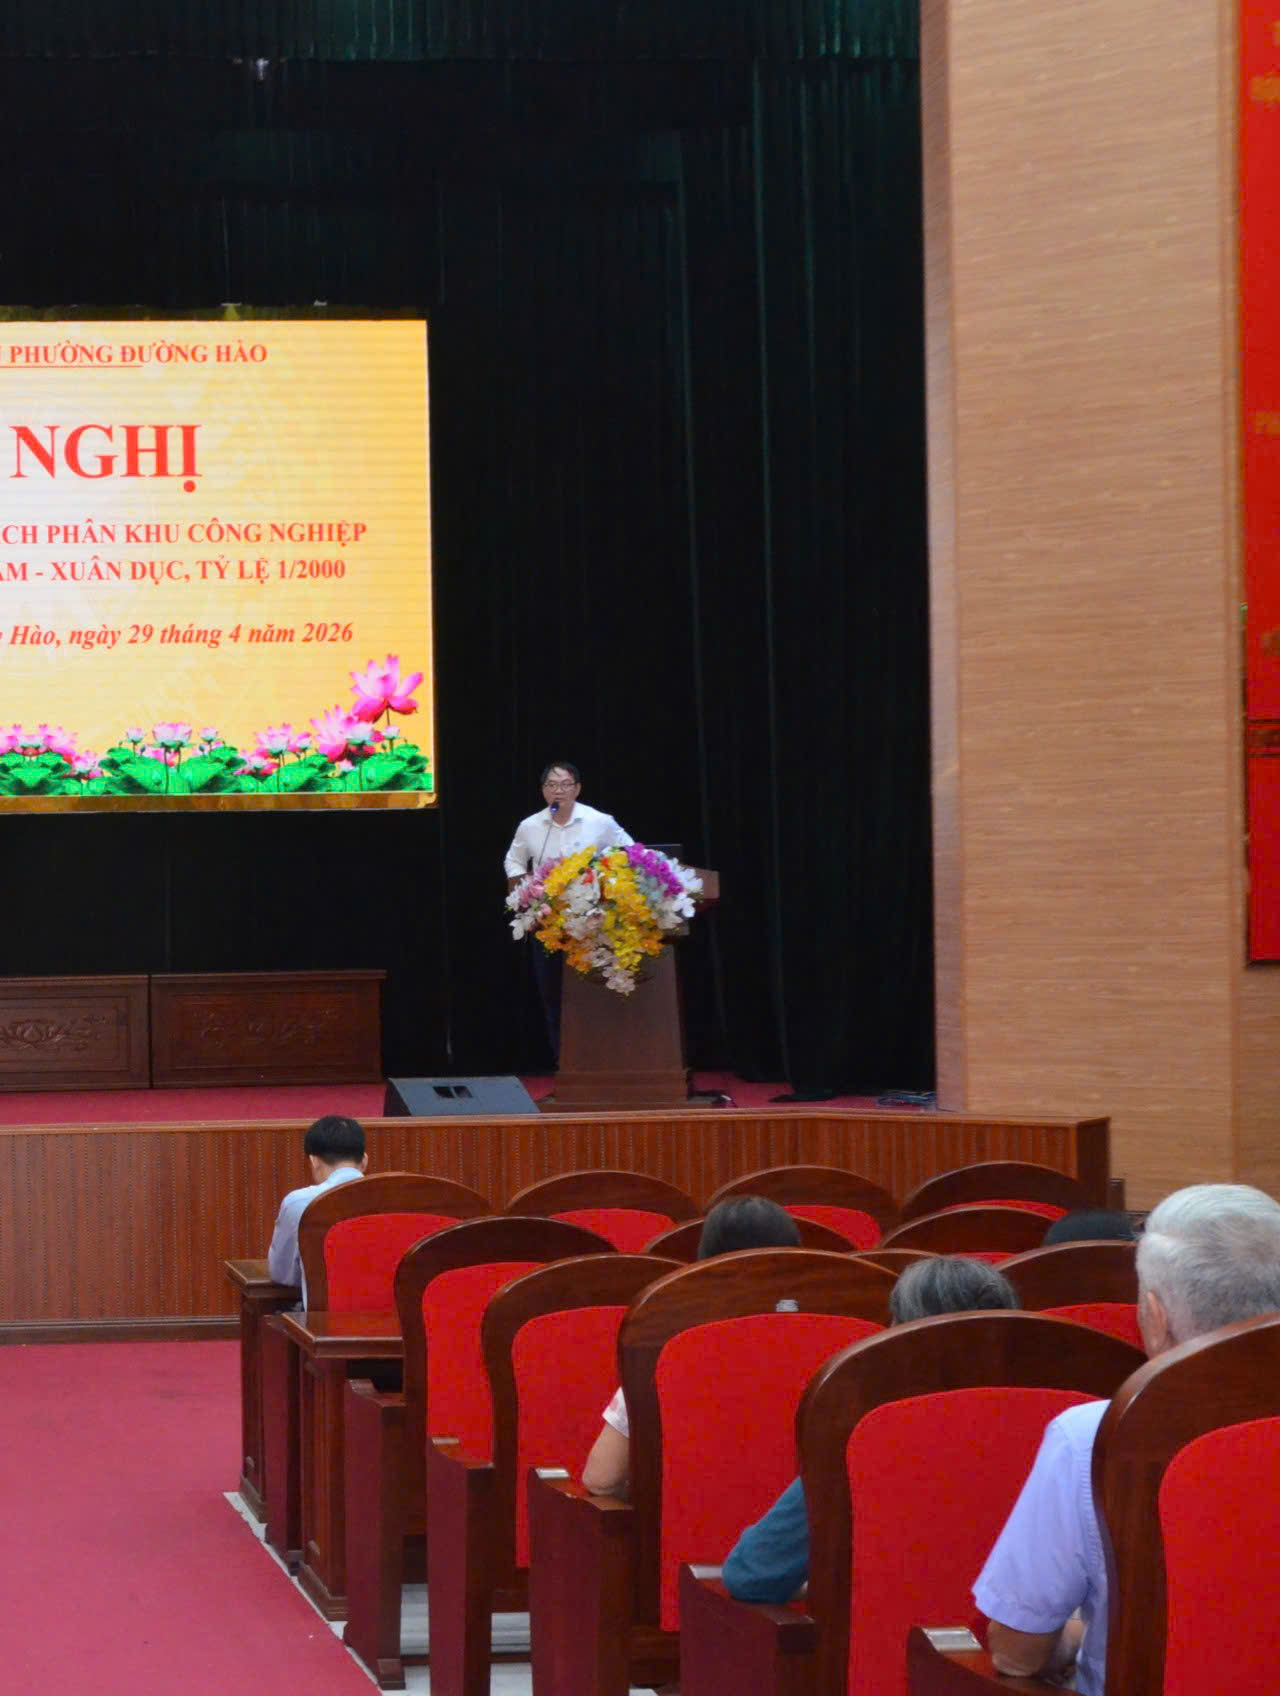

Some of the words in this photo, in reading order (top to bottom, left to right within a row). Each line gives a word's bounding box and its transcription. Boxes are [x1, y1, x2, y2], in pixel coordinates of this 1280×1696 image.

[10, 340, 113, 364] PHƯỜNG
[120, 339, 209, 364] ĐƯỜNG
[215, 339, 268, 364] HÀO
[9, 423, 202, 494] NGHỊ
[47, 518, 116, 545] PHÂN
[125, 523, 180, 544] KHU
[187, 517, 263, 544] CÔNG
[269, 519, 367, 548] NGHIỆP
[51, 555, 121, 582] XUÂN
[130, 560, 191, 585] DỤC,
[196, 555, 230, 581] TỶ
[238, 556, 269, 585] LỆ
[279, 559, 346, 580] 1/2000
[9, 625, 61, 649] Hào,
[68, 624, 121, 650] ngày
[128, 623, 155, 645] 29
[159, 623, 223, 649] tháng
[228, 623, 242, 644] 4
[247, 624, 296, 644] năm
[301, 622, 354, 643] 2026
